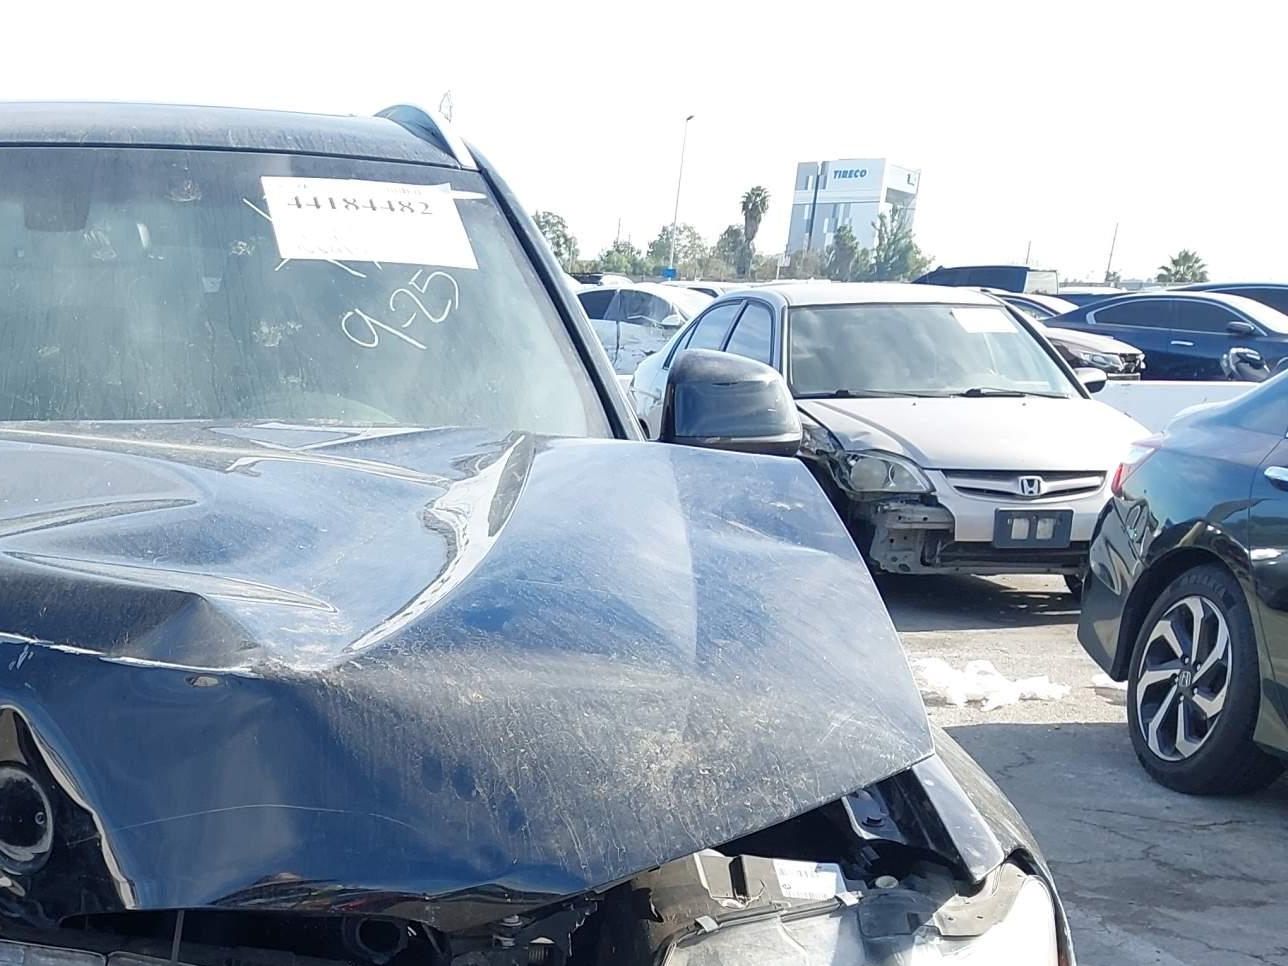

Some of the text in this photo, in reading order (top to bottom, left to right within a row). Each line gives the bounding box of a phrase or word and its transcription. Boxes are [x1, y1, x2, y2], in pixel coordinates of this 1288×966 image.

[833, 169, 867, 179] TIRECO
[287, 195, 433, 215] 44184482
[341, 268, 460, 349] 9-25
